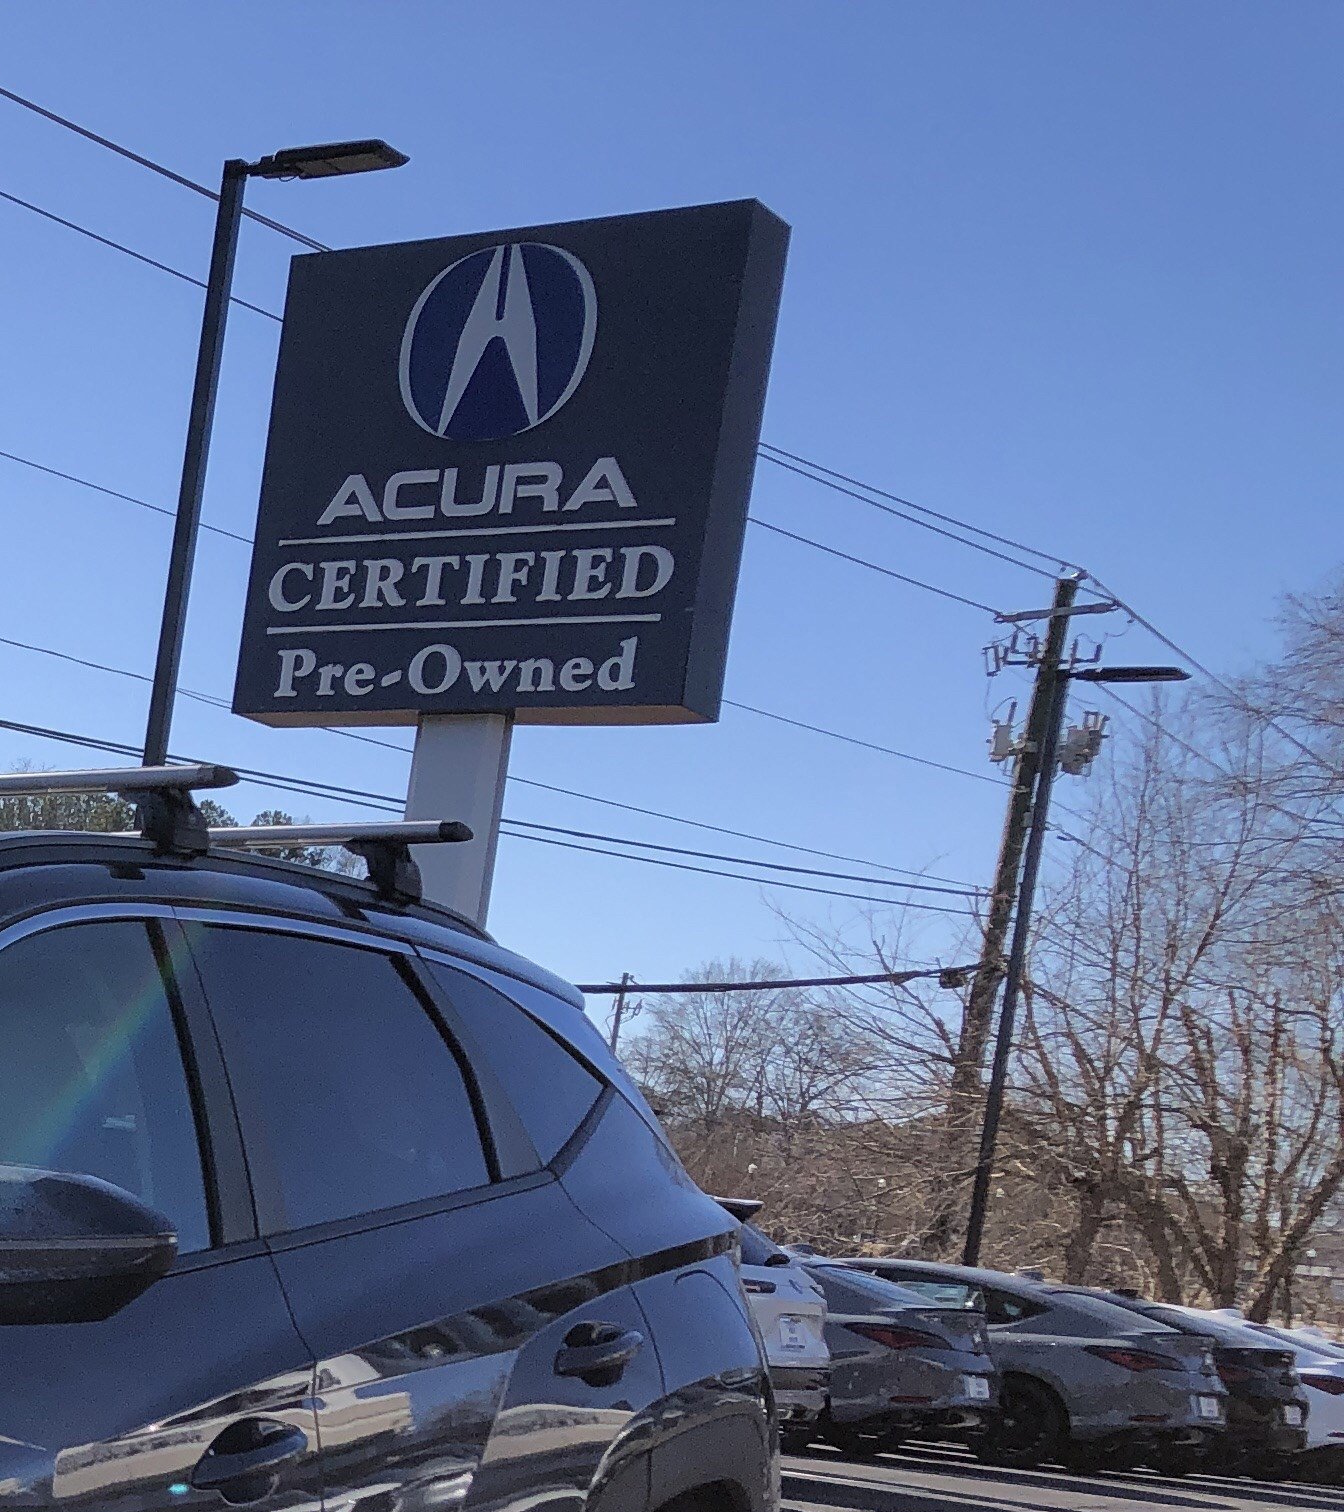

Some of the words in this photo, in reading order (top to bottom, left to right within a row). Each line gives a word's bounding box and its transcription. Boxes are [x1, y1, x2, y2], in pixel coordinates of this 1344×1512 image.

[317, 456, 638, 526] ACURA
[267, 545, 675, 613] CERTIFIED
[273, 635, 639, 699] Pre-Owned
